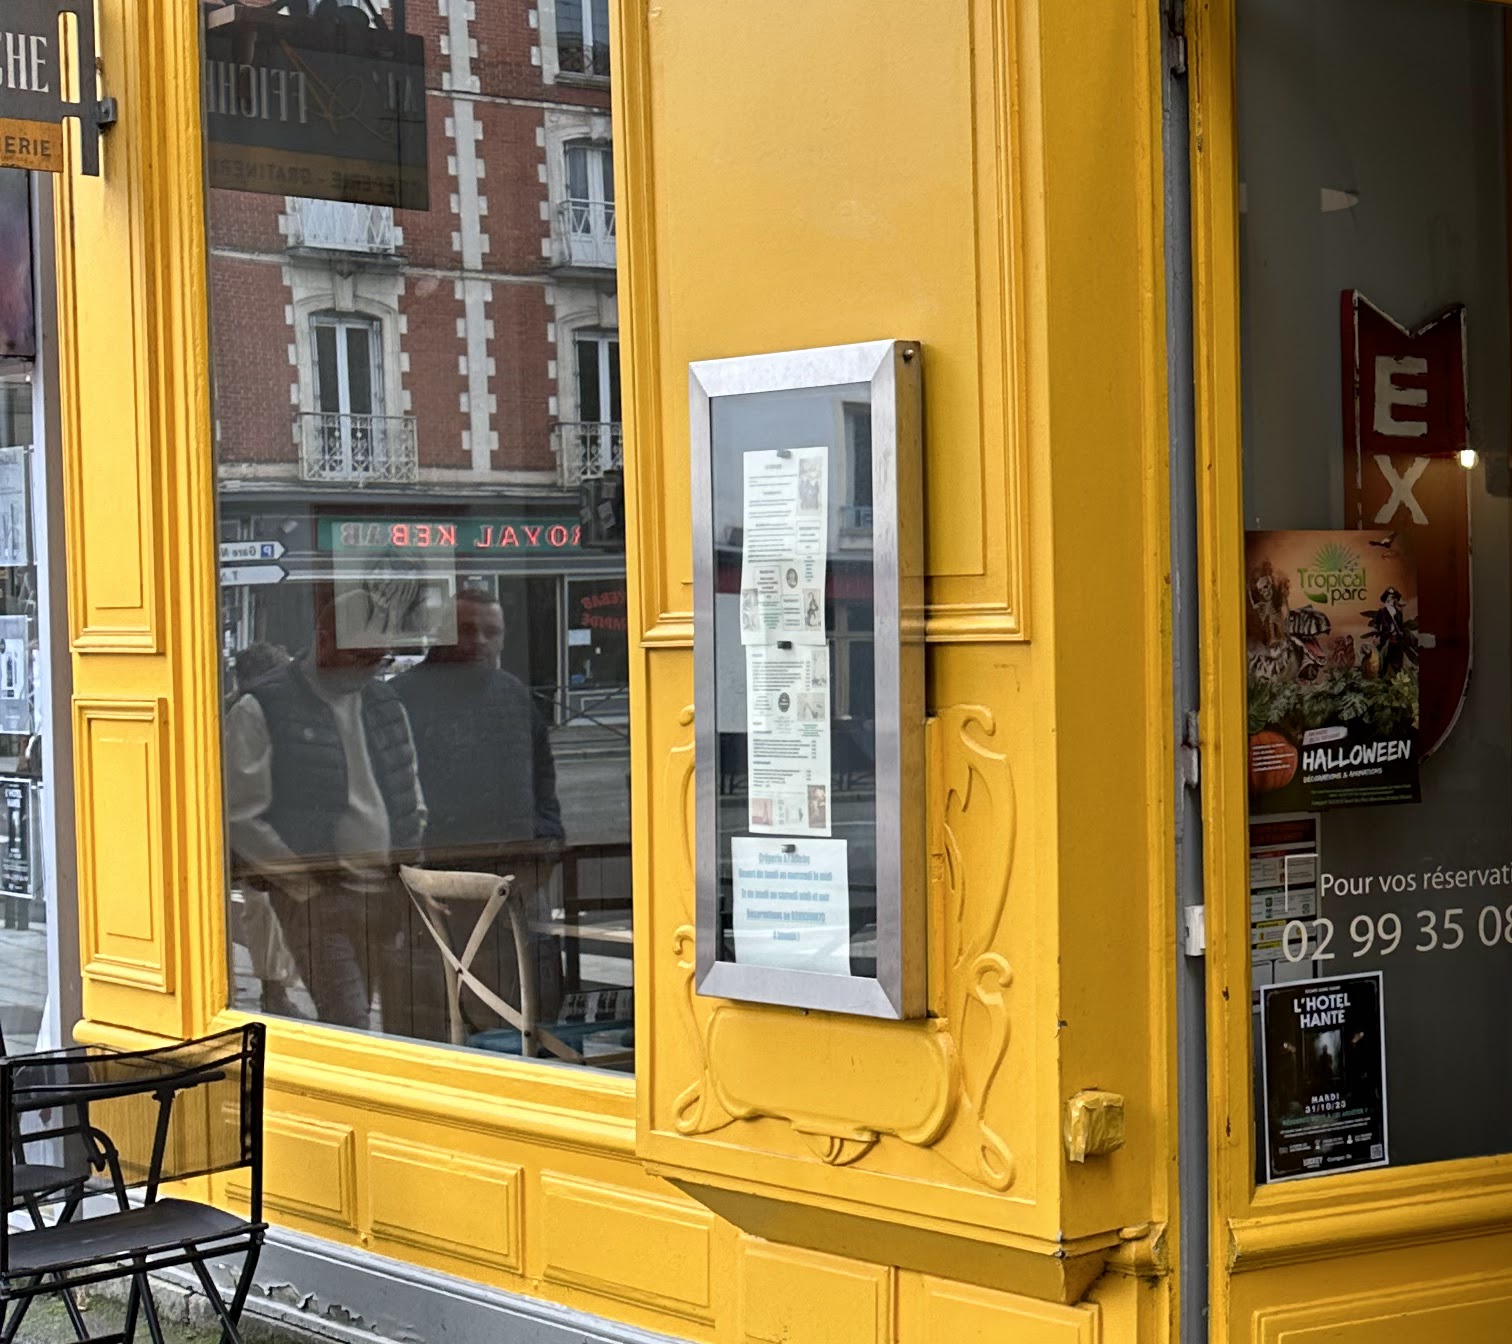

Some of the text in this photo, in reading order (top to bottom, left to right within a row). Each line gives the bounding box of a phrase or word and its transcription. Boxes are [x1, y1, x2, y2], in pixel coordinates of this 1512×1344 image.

[0, 32, 49, 92] HE
[1297, 567, 1366, 593] Tropical
[1331, 588, 1367, 606] parc
[1302, 739, 1412, 772] HALLOWEEN
[1321, 872, 1373, 897] Pour
[1379, 874, 1416, 893] vos
[1282, 917, 1335, 963] 02
[1350, 912, 1401, 958] 99
[1416, 908, 1464, 952] 35
